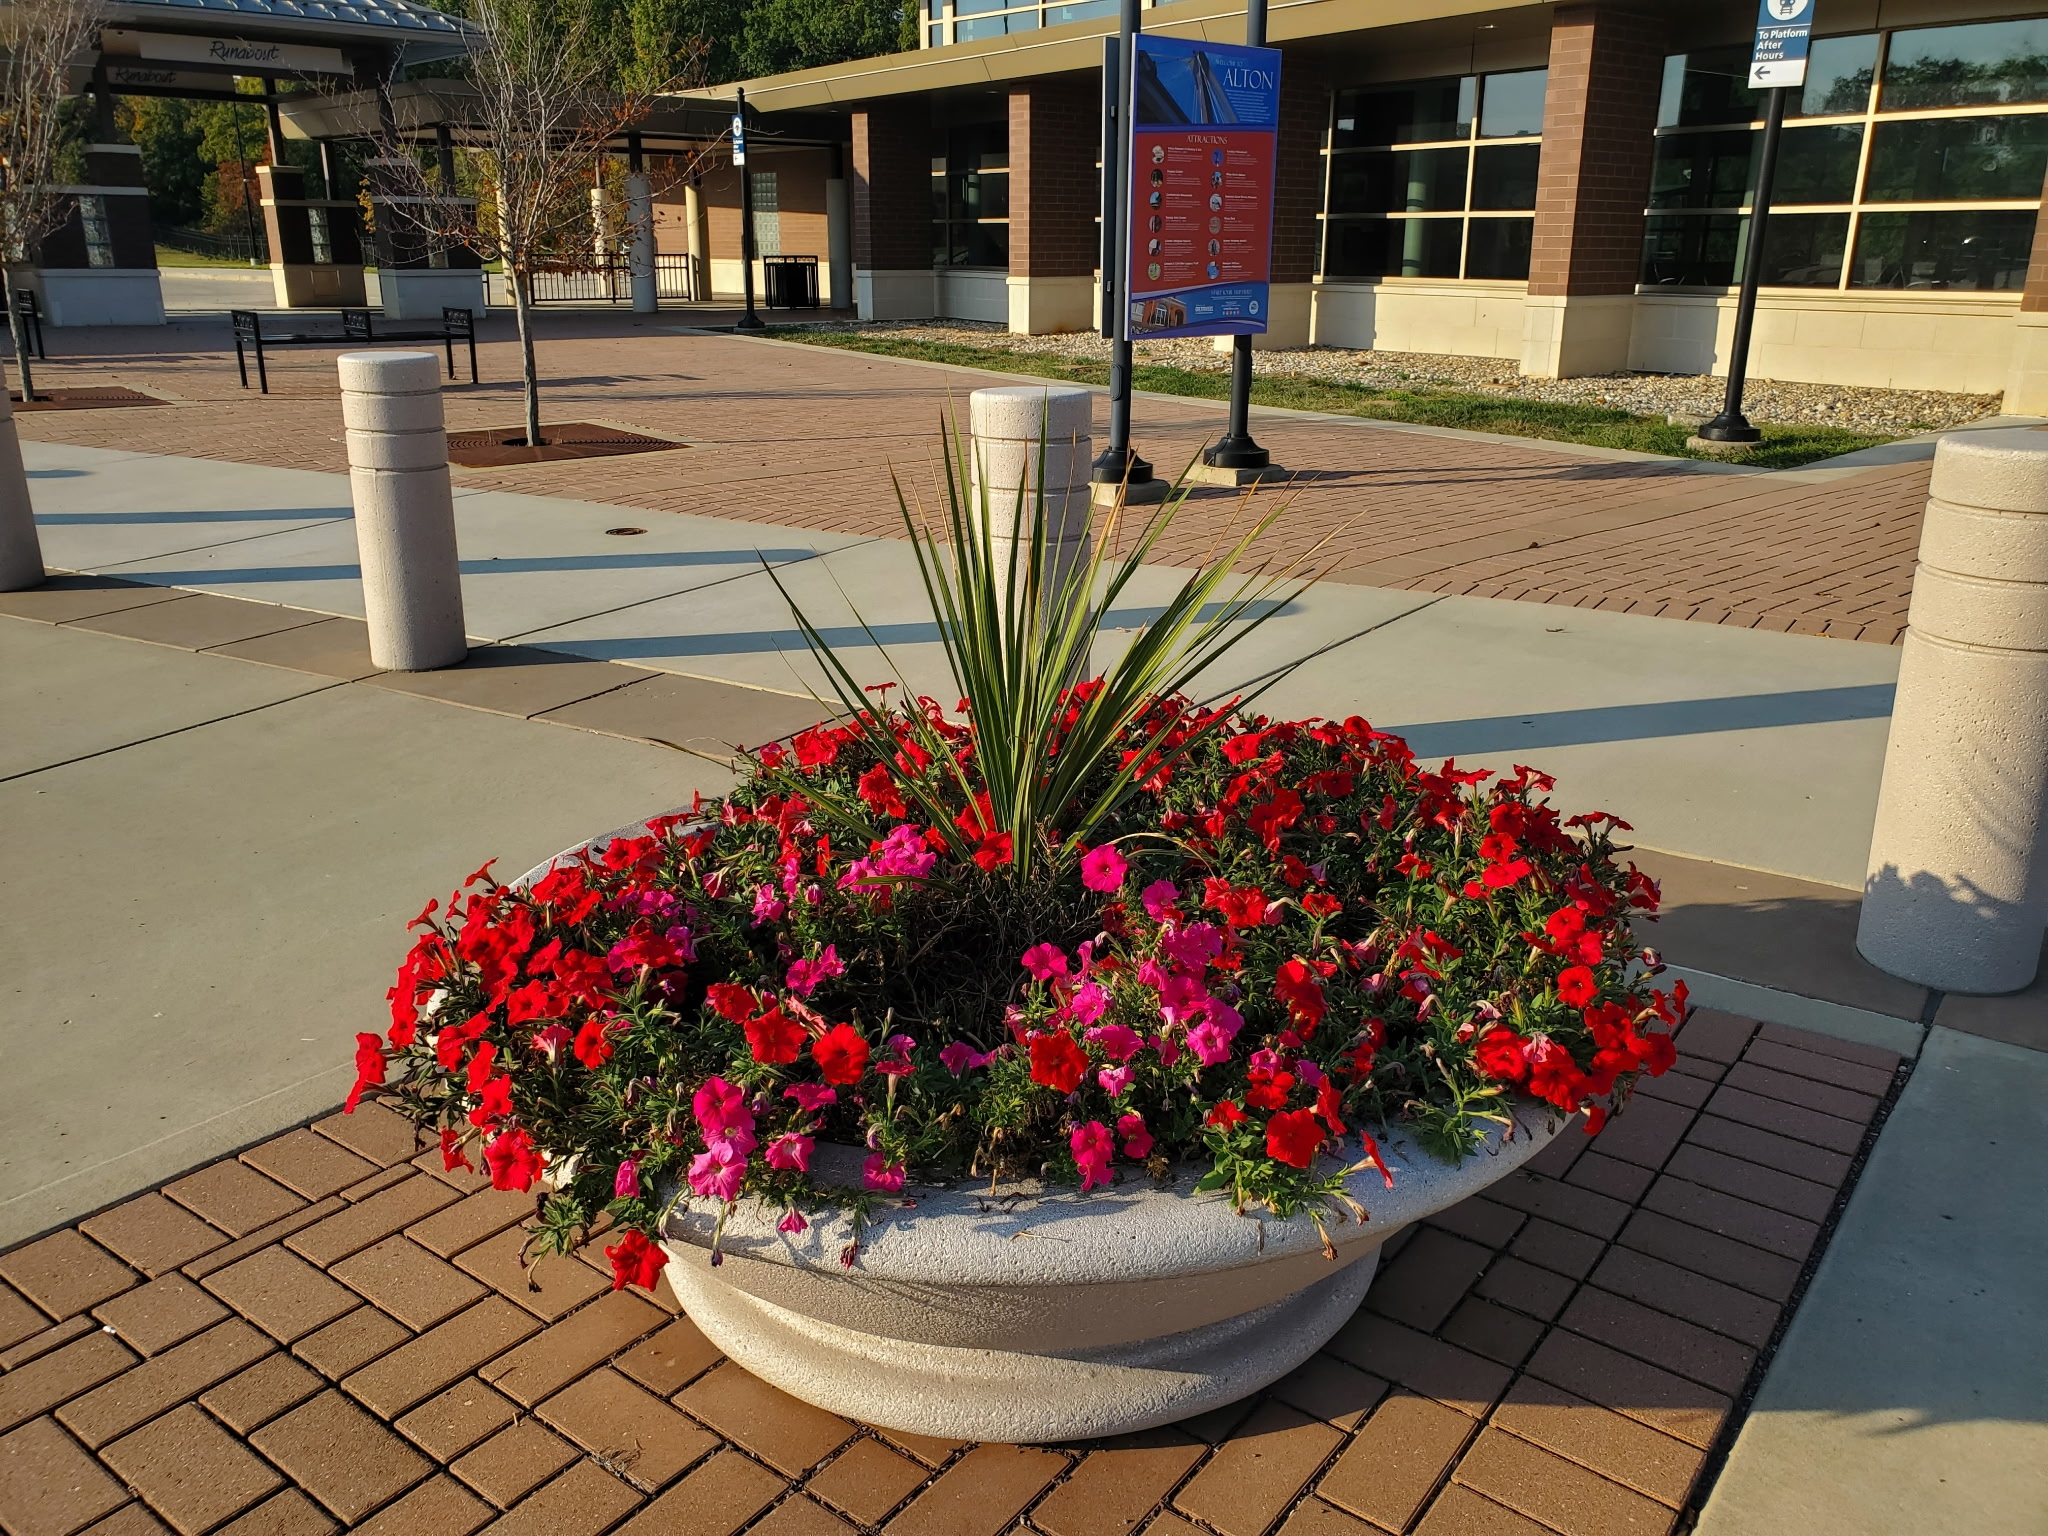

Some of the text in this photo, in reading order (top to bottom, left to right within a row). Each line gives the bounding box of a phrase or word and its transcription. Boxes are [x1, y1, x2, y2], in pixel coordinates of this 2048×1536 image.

[1758, 28, 1808, 40] To Platform
[209, 40, 280, 62] Runabout
[1756, 40, 1783, 50] After
[1755, 51, 1784, 60] Hours
[115, 67, 177, 84] Runabout
[1222, 67, 1274, 90] ALTON
[1187, 134, 1228, 145] ATTRACTIONS
